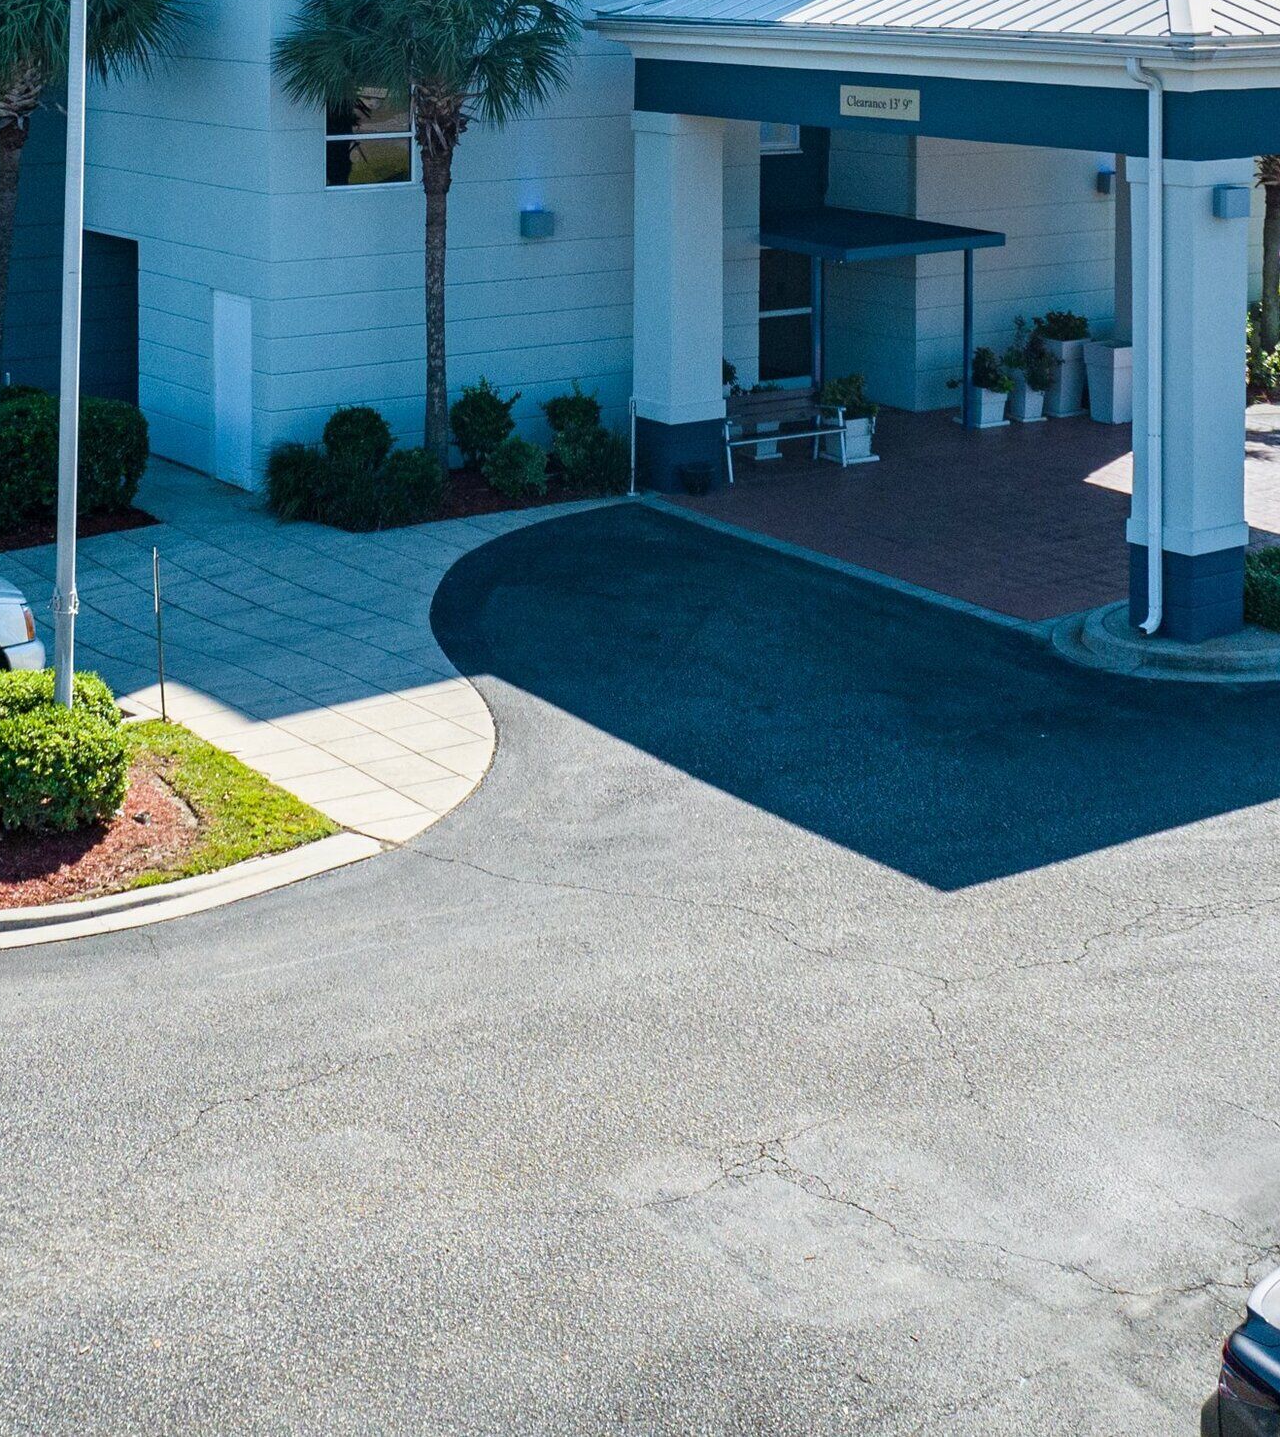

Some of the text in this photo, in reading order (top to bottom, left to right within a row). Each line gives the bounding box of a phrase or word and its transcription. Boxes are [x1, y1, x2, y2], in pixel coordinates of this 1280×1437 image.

[846, 95, 913, 110] Clearance 13' 9"
